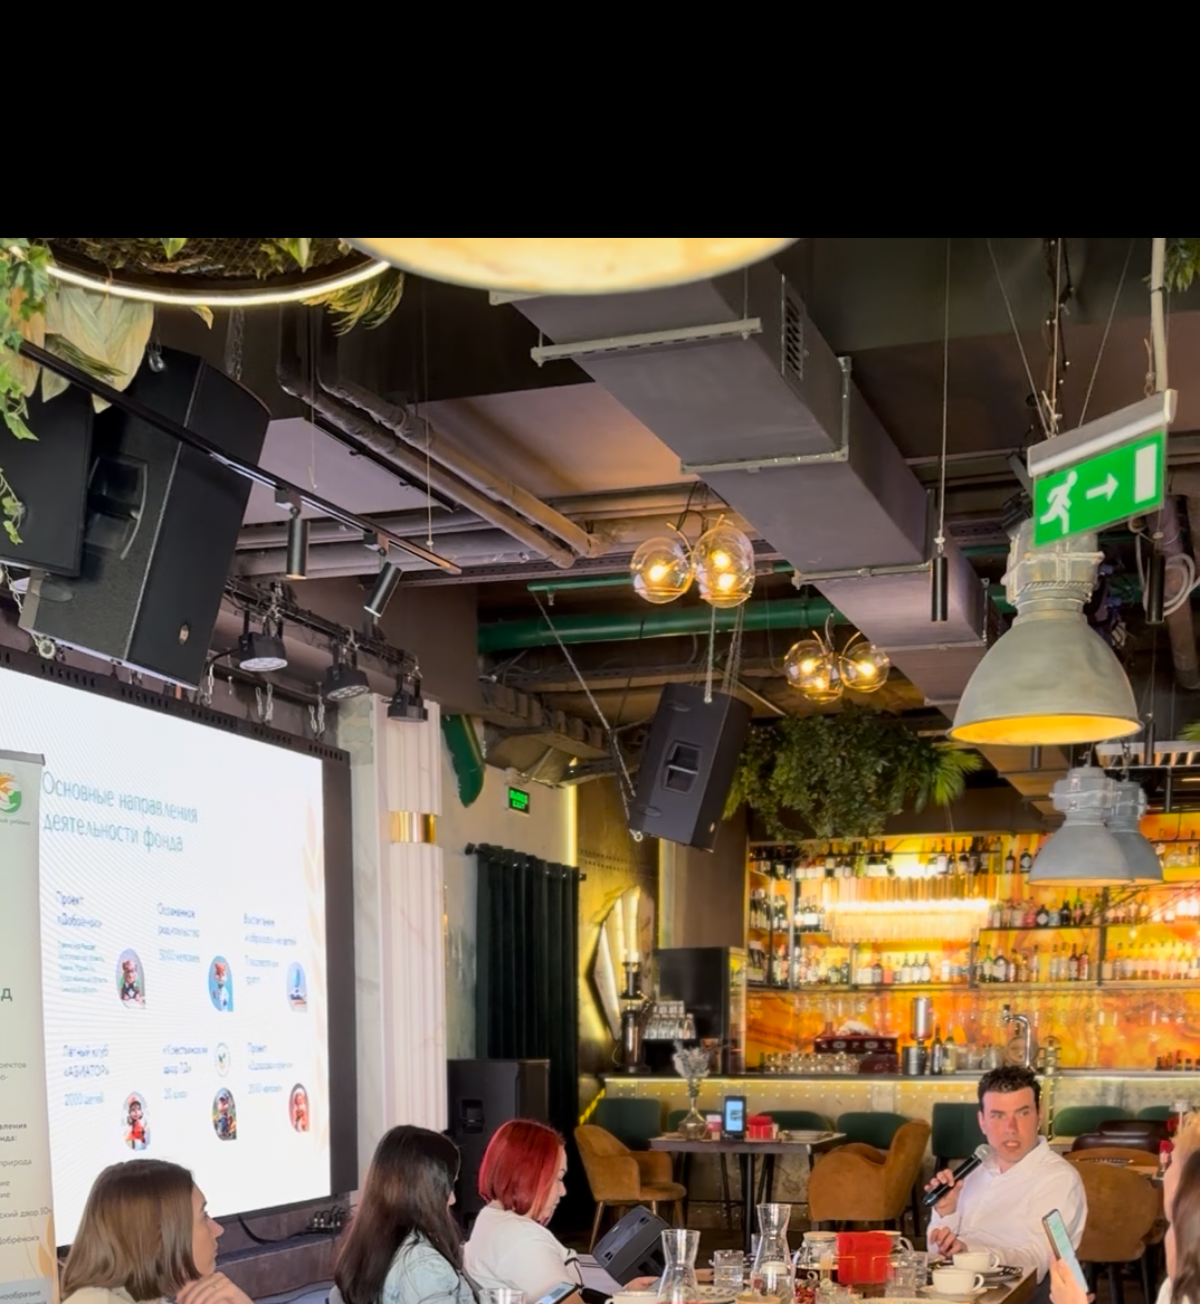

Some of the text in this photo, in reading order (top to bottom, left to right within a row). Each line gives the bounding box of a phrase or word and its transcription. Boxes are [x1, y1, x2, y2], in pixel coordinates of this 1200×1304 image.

[43, 771, 198, 823] Основные направления
[44, 814, 183, 852] деятельности фонда
